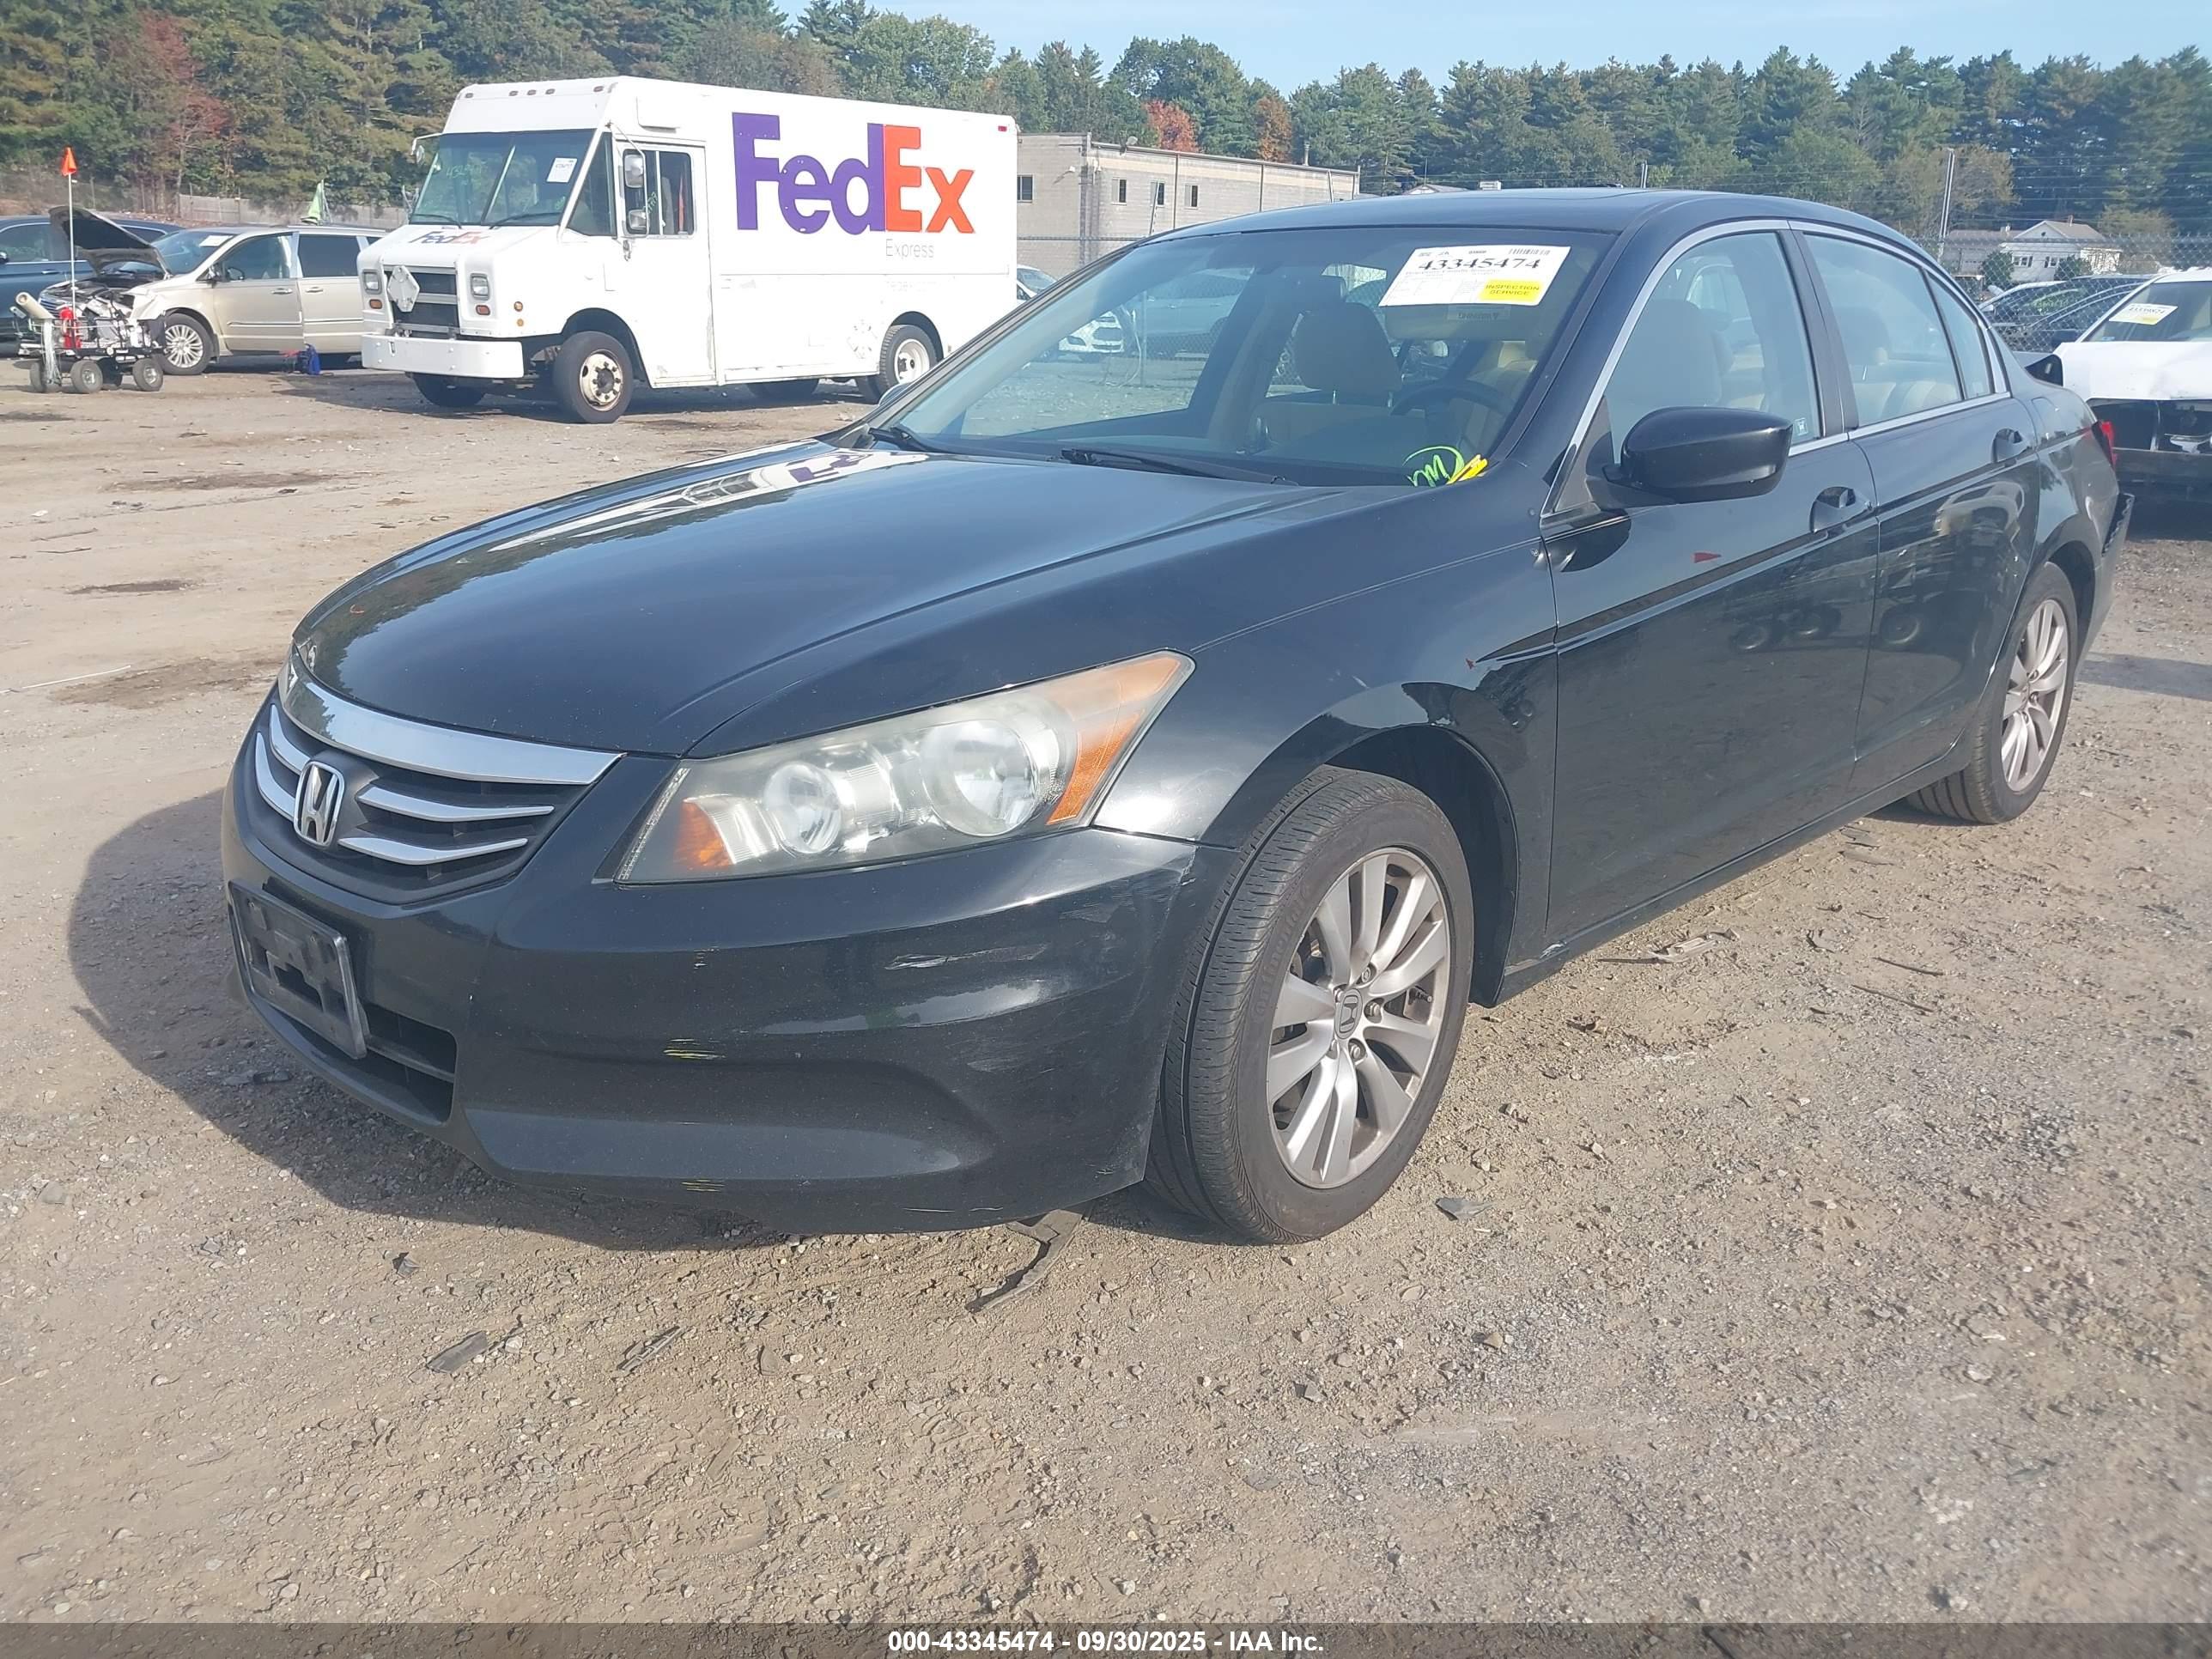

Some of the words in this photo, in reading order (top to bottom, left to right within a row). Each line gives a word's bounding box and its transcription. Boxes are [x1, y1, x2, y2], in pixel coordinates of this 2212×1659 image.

[732, 112, 975, 234] FedEx
[885, 238, 934, 259] Express
[1419, 258, 1540, 270] 43345474
